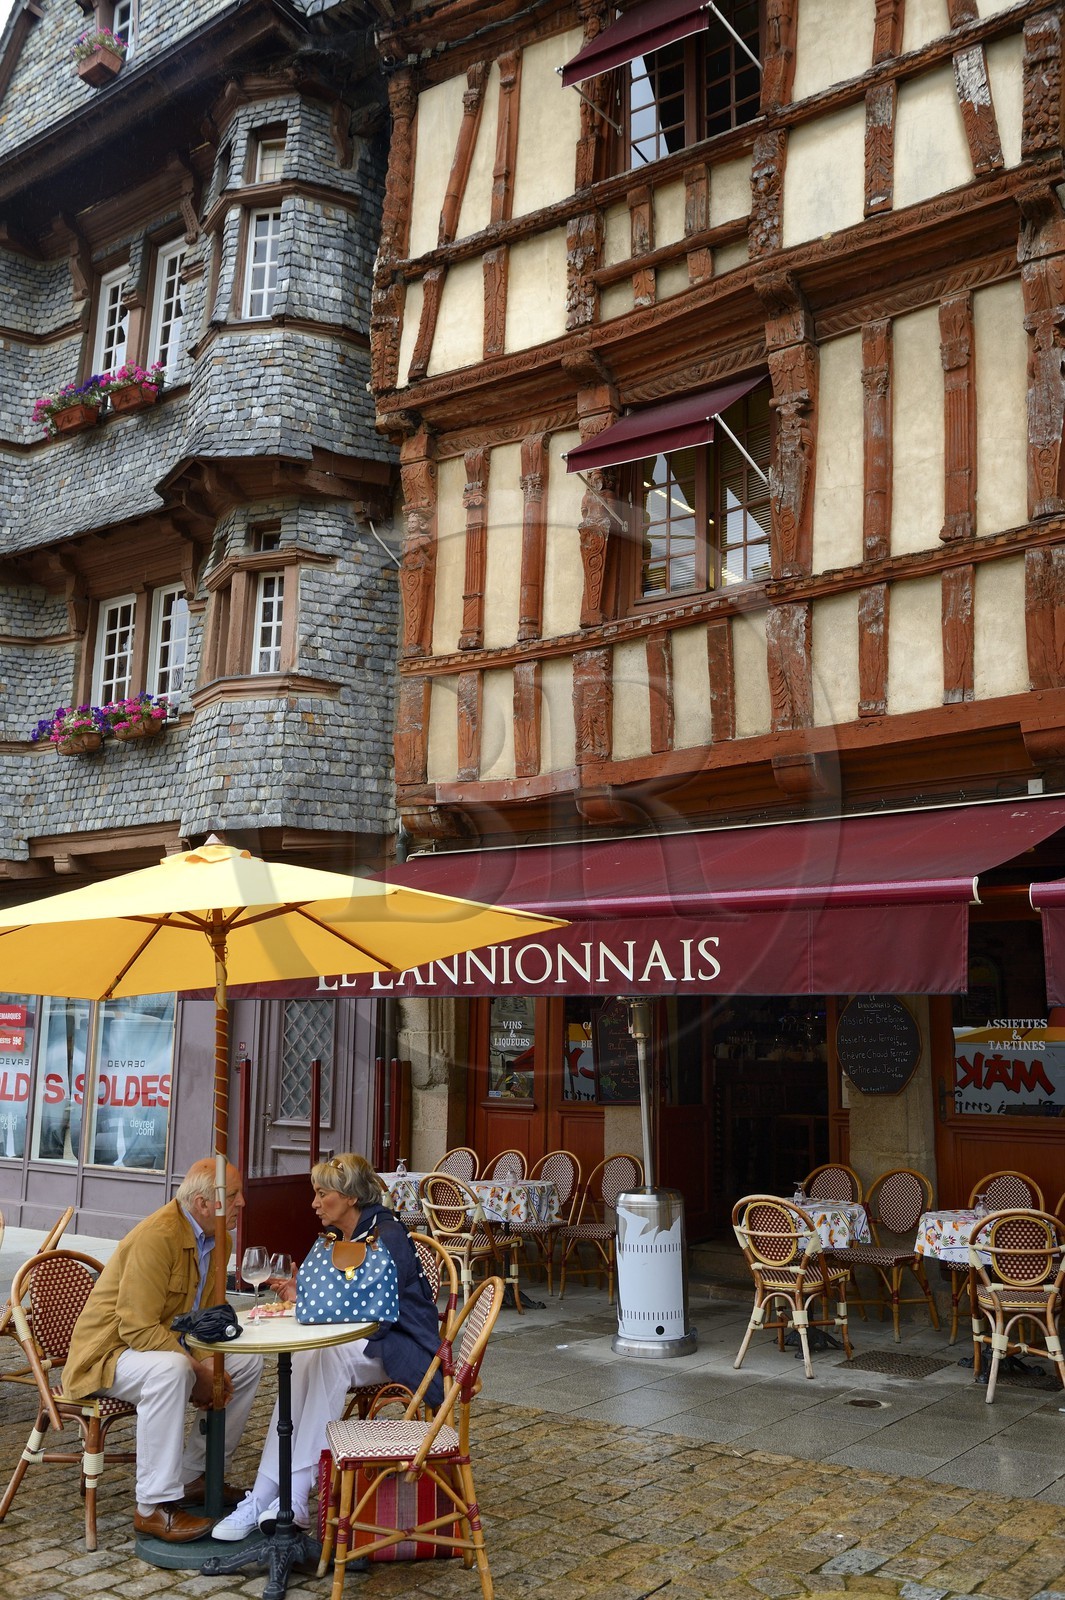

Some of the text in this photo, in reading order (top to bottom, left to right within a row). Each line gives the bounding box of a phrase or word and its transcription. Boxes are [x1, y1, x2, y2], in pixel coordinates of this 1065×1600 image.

[502, 1020, 523, 1030] VINS
[986, 1018, 1048, 1029] ASSIETTES
[509, 1029, 517, 1038] &
[1012, 1029, 1022, 1041] &
[494, 1037, 530, 1048] LIQUEURS
[988, 1040, 1046, 1051] TARTINES
[130, 1118, 155, 1129] devred
[136, 1128, 155, 1136] .com
